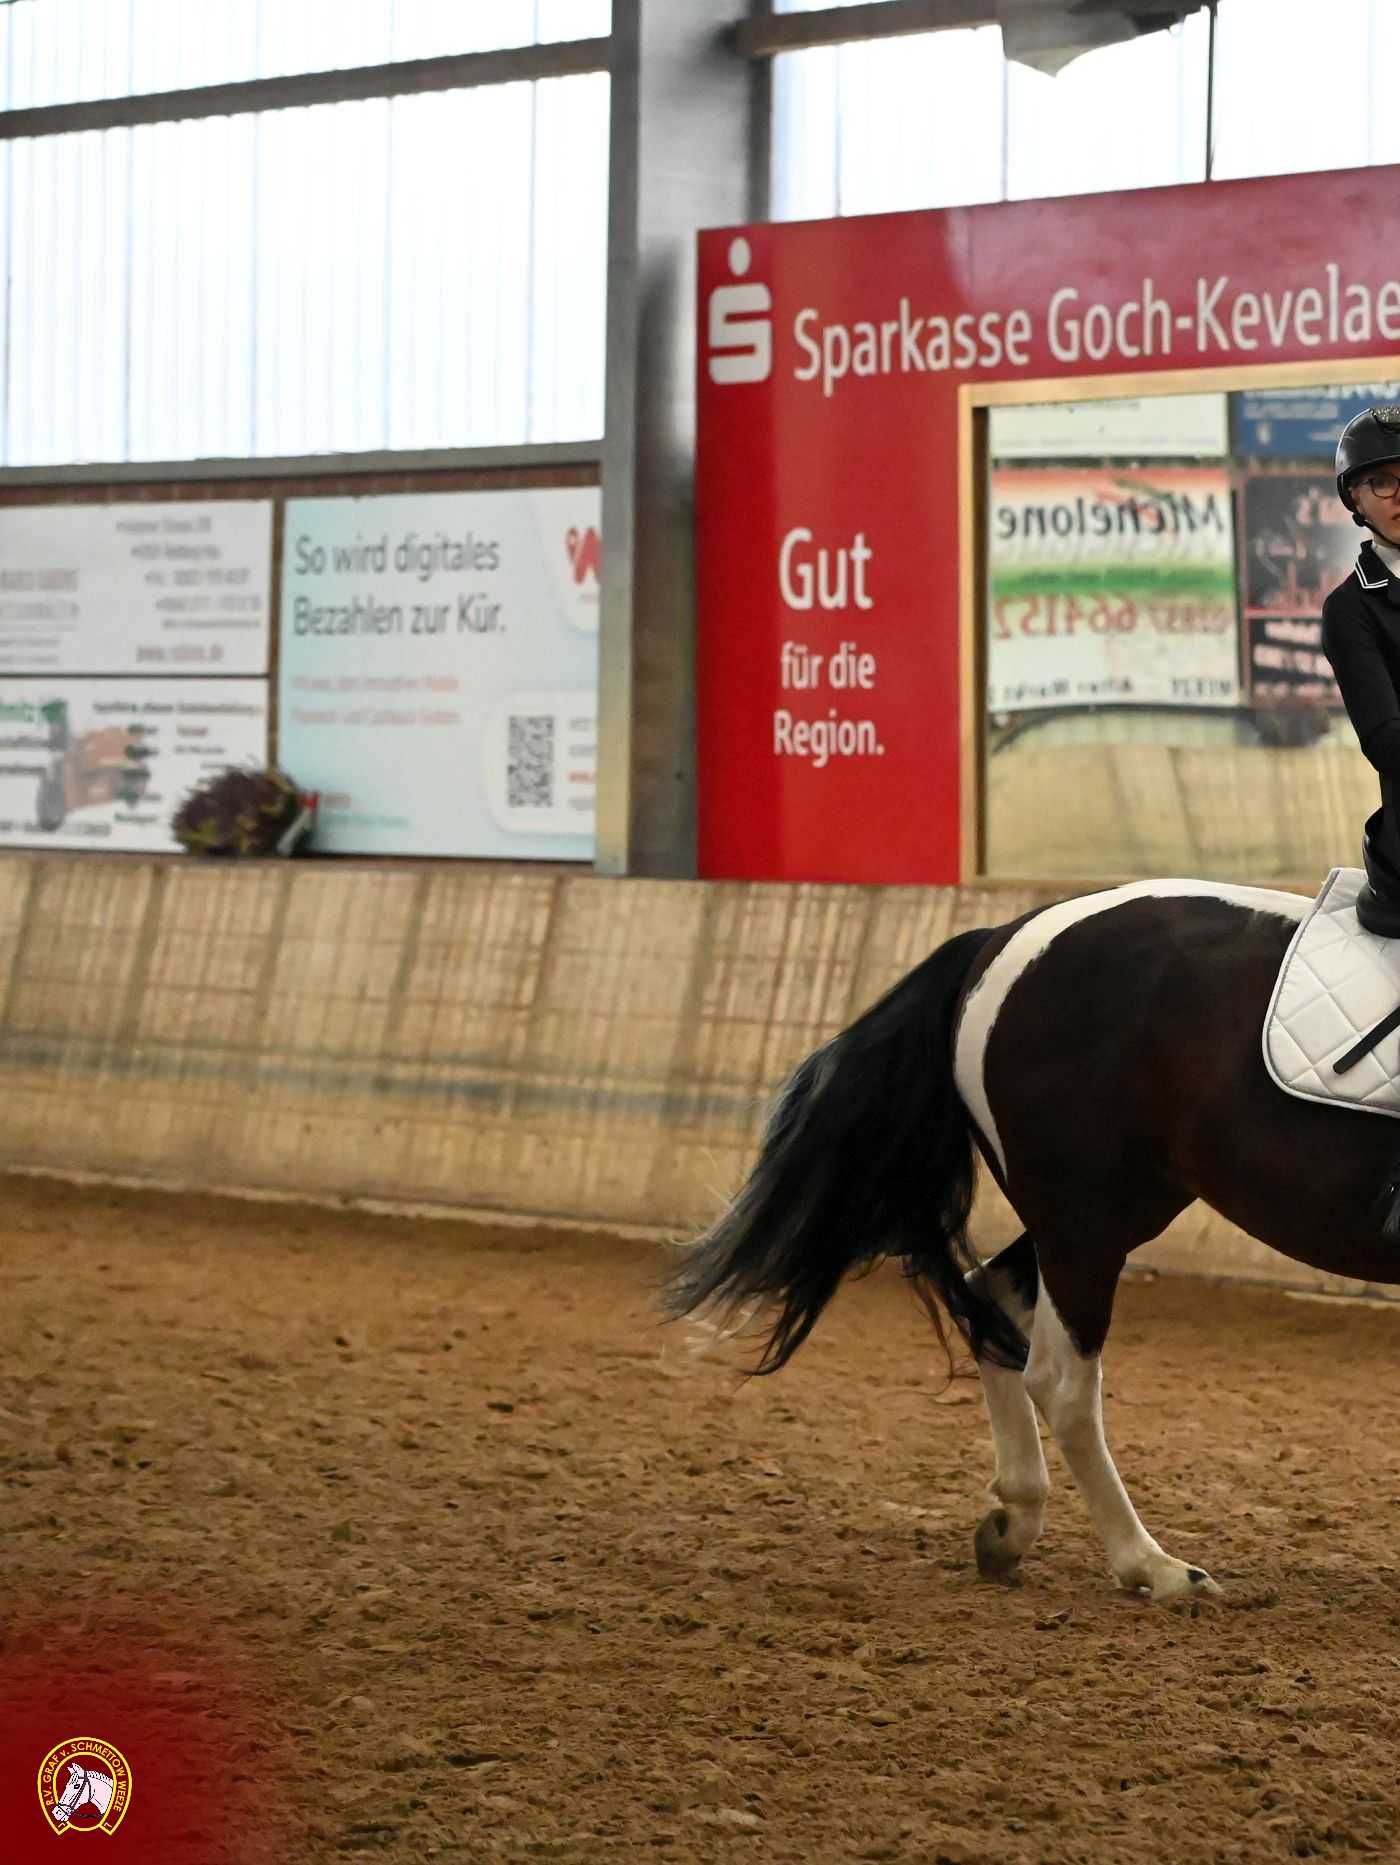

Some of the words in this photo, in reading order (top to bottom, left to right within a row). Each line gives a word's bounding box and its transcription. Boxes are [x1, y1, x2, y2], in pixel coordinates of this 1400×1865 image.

[793, 297, 1032, 397] Sparkasse
[295, 536, 326, 575] So
[333, 532, 387, 573] wird
[394, 531, 499, 582] digitales
[778, 527, 873, 610] Gut
[294, 595, 402, 636] Bezahlen
[411, 605, 449, 635] zur
[780, 641, 821, 689] für
[829, 641, 876, 689] die
[774, 709, 885, 768] Region.
